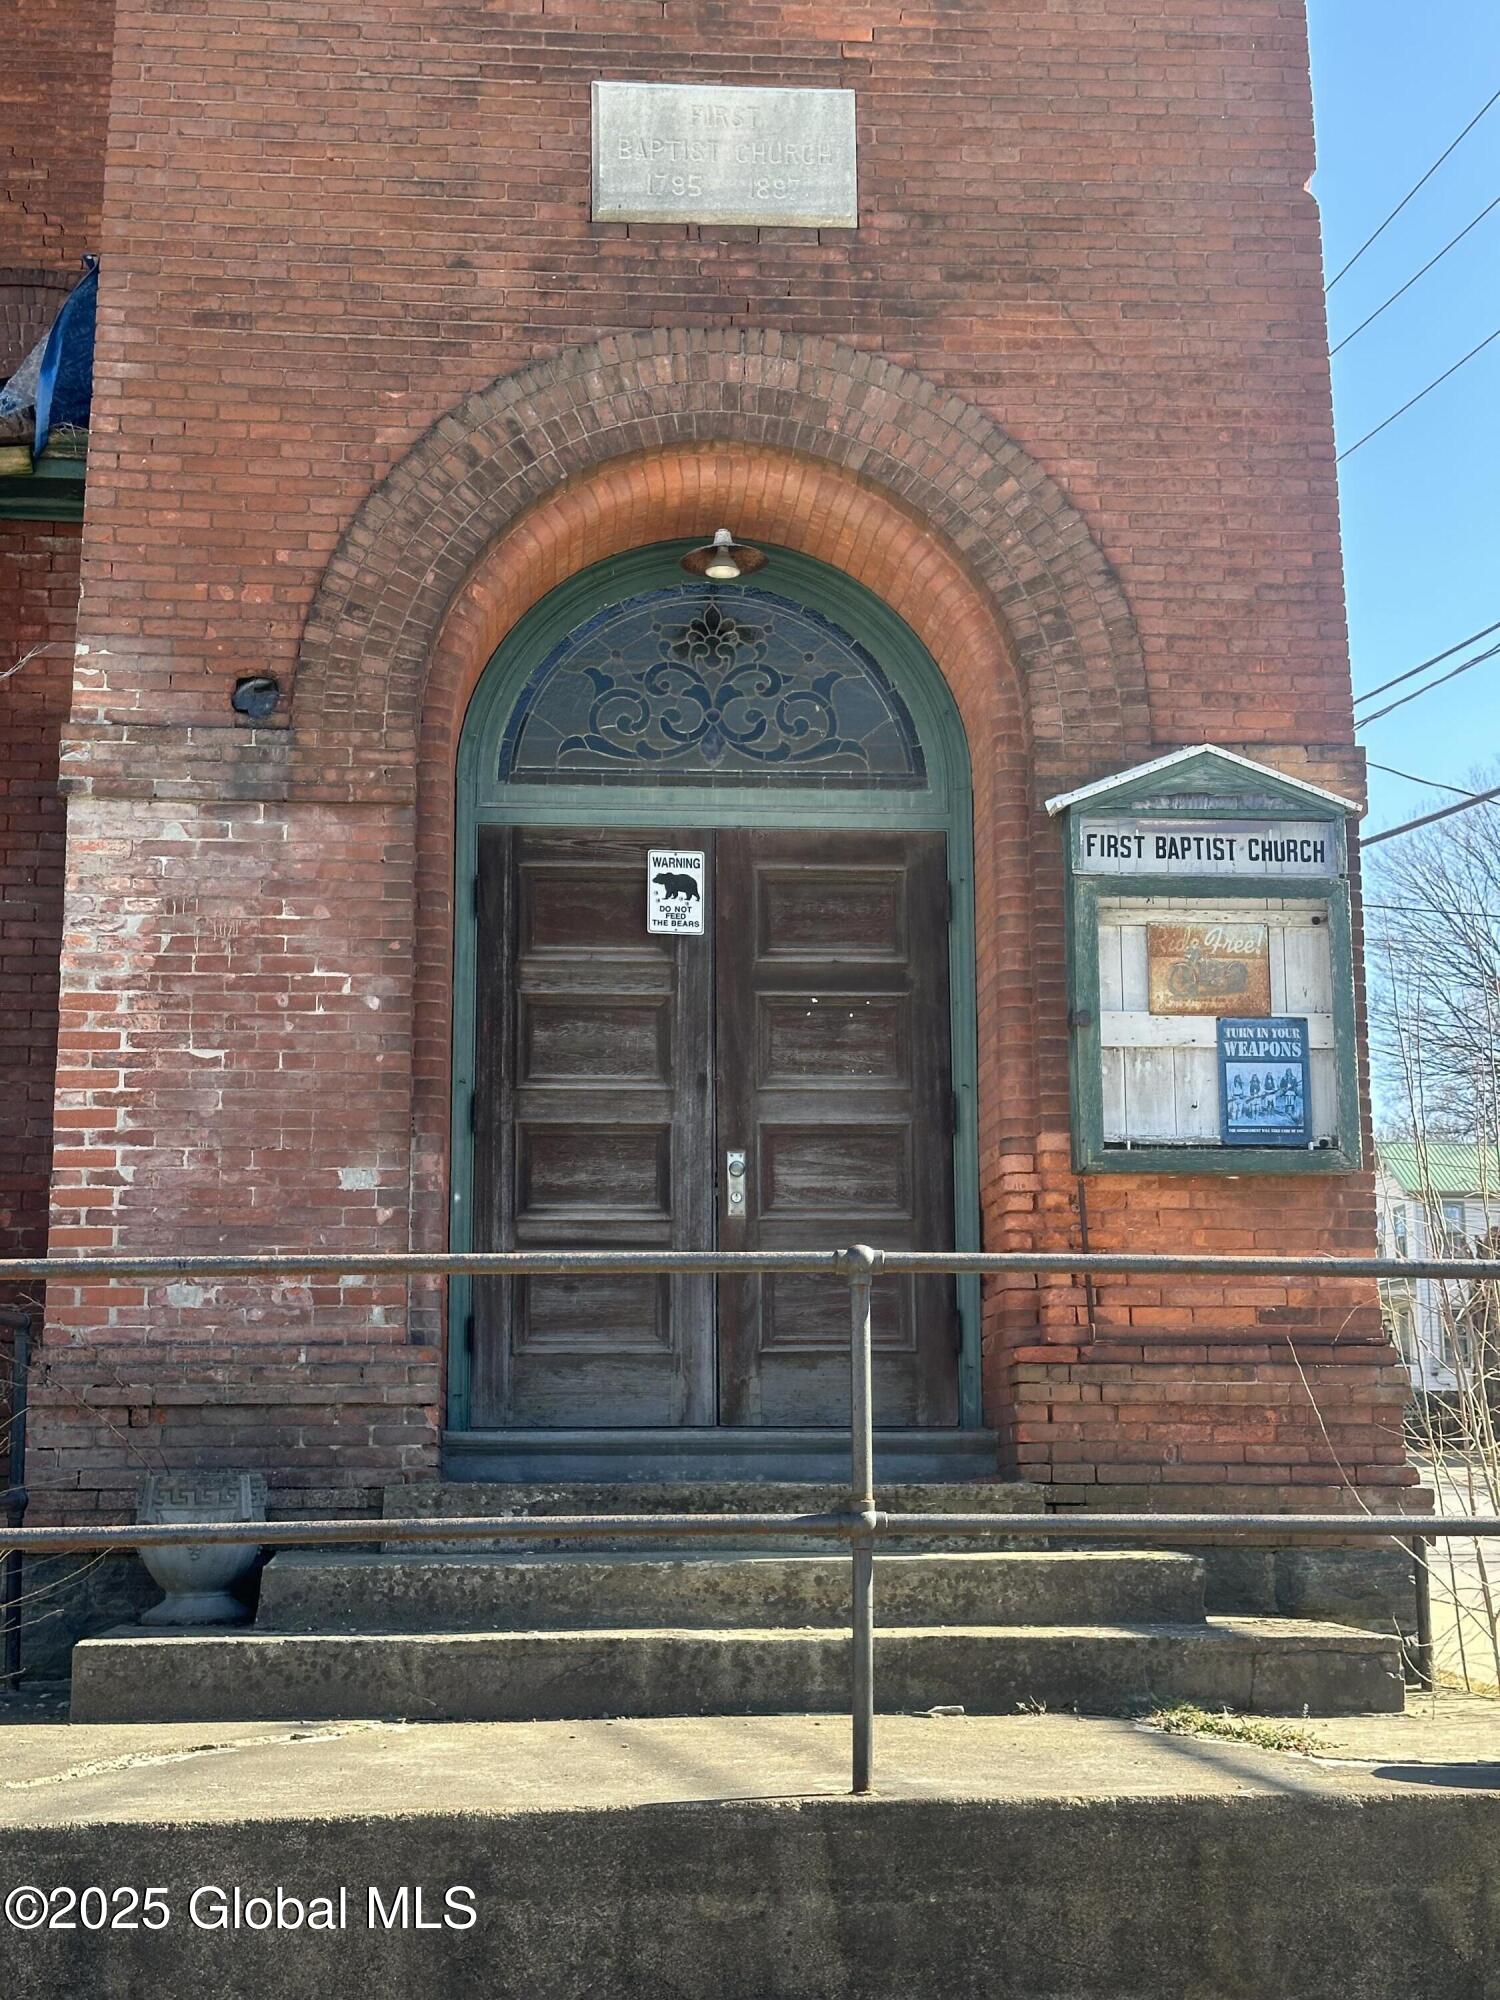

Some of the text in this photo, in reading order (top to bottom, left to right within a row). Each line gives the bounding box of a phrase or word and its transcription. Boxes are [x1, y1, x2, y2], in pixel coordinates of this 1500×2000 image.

[690, 104, 761, 129] FIRST
[618, 138, 833, 166] BAPTIST CHURCH
[647, 174, 703, 197] 1795
[1086, 833, 1326, 863] FIRST BAPTIST CHURCH
[652, 857, 700, 869] WARNING
[1204, 927, 1264, 958] Free!
[1224, 1027, 1301, 1039] TURN IN YOUR
[1223, 1041, 1302, 1057] WEAPONS
